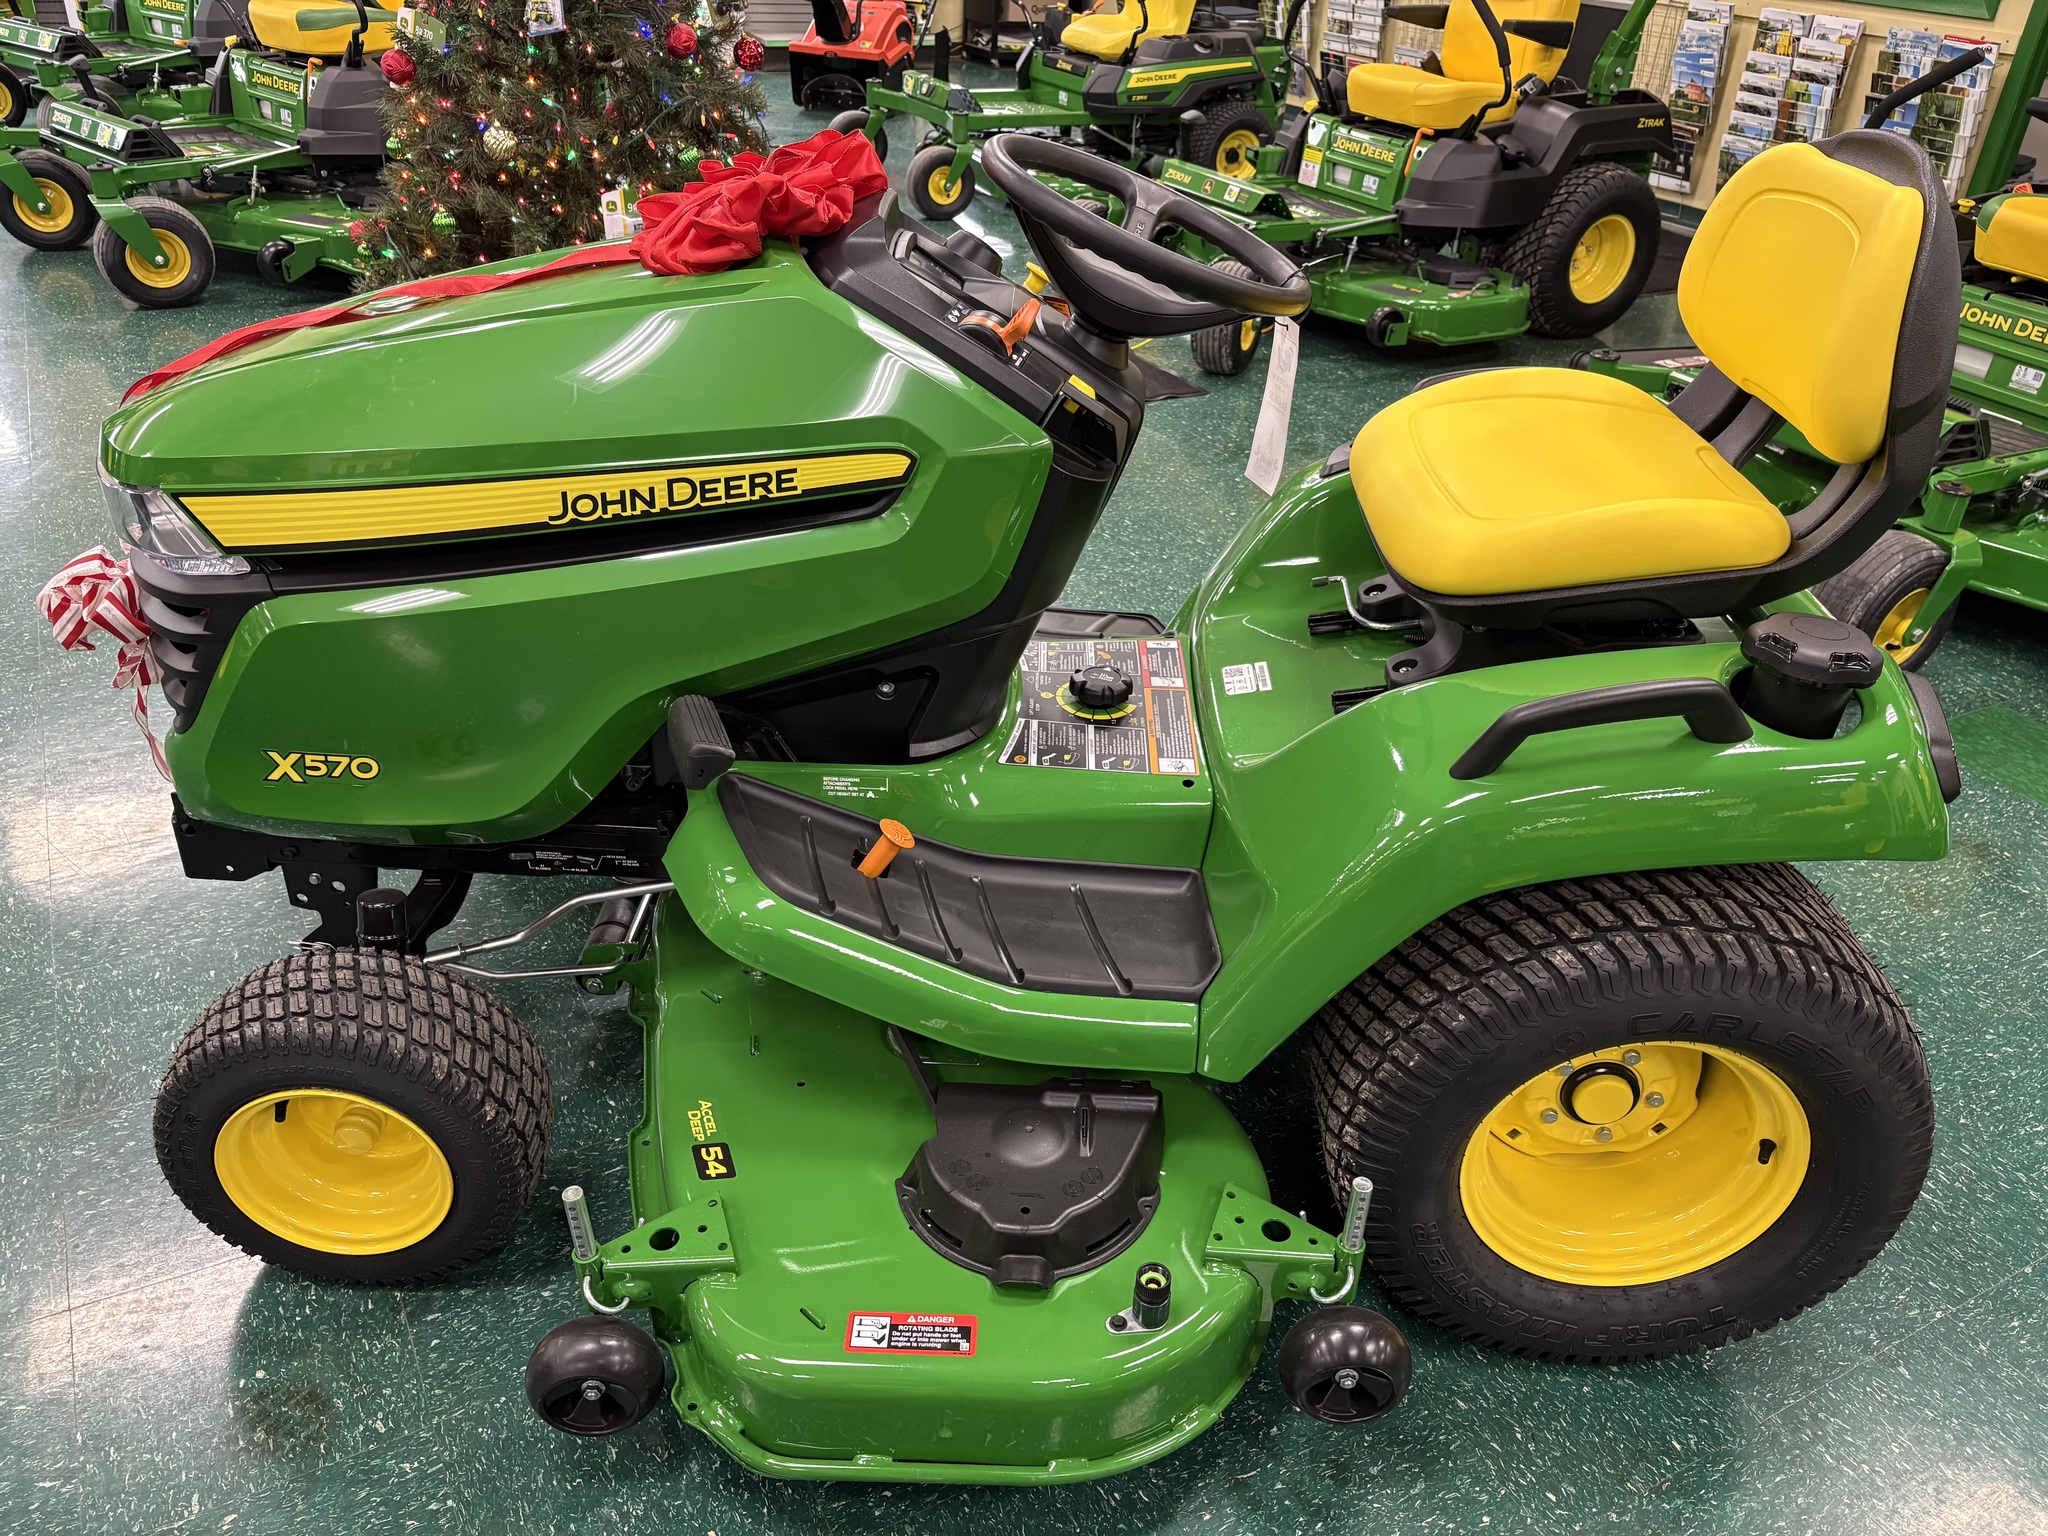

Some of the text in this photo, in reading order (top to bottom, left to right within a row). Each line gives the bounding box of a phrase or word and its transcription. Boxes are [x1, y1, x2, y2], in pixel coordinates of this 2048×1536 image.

[162, 0, 186, 13] DEERE
[252, 72, 300, 95] JOHN DEERE
[1135, 75, 1154, 83] JOHN
[1637, 117, 1666, 130] ZTRAK
[1332, 135, 1396, 164] JOHN DEERE
[1960, 302, 2013, 333] JOHN
[547, 468, 800, 523] JOHN DEERE
[262, 749, 381, 784] X570
[1627, 1010, 1875, 1113] CARLSTAR
[687, 1110, 706, 1142] DEEP
[698, 1100, 718, 1137] ACCEL
[700, 1146, 728, 1178] 54
[1409, 1220, 1737, 1348] TURF MASTER
[917, 1316, 955, 1324] DANGER
